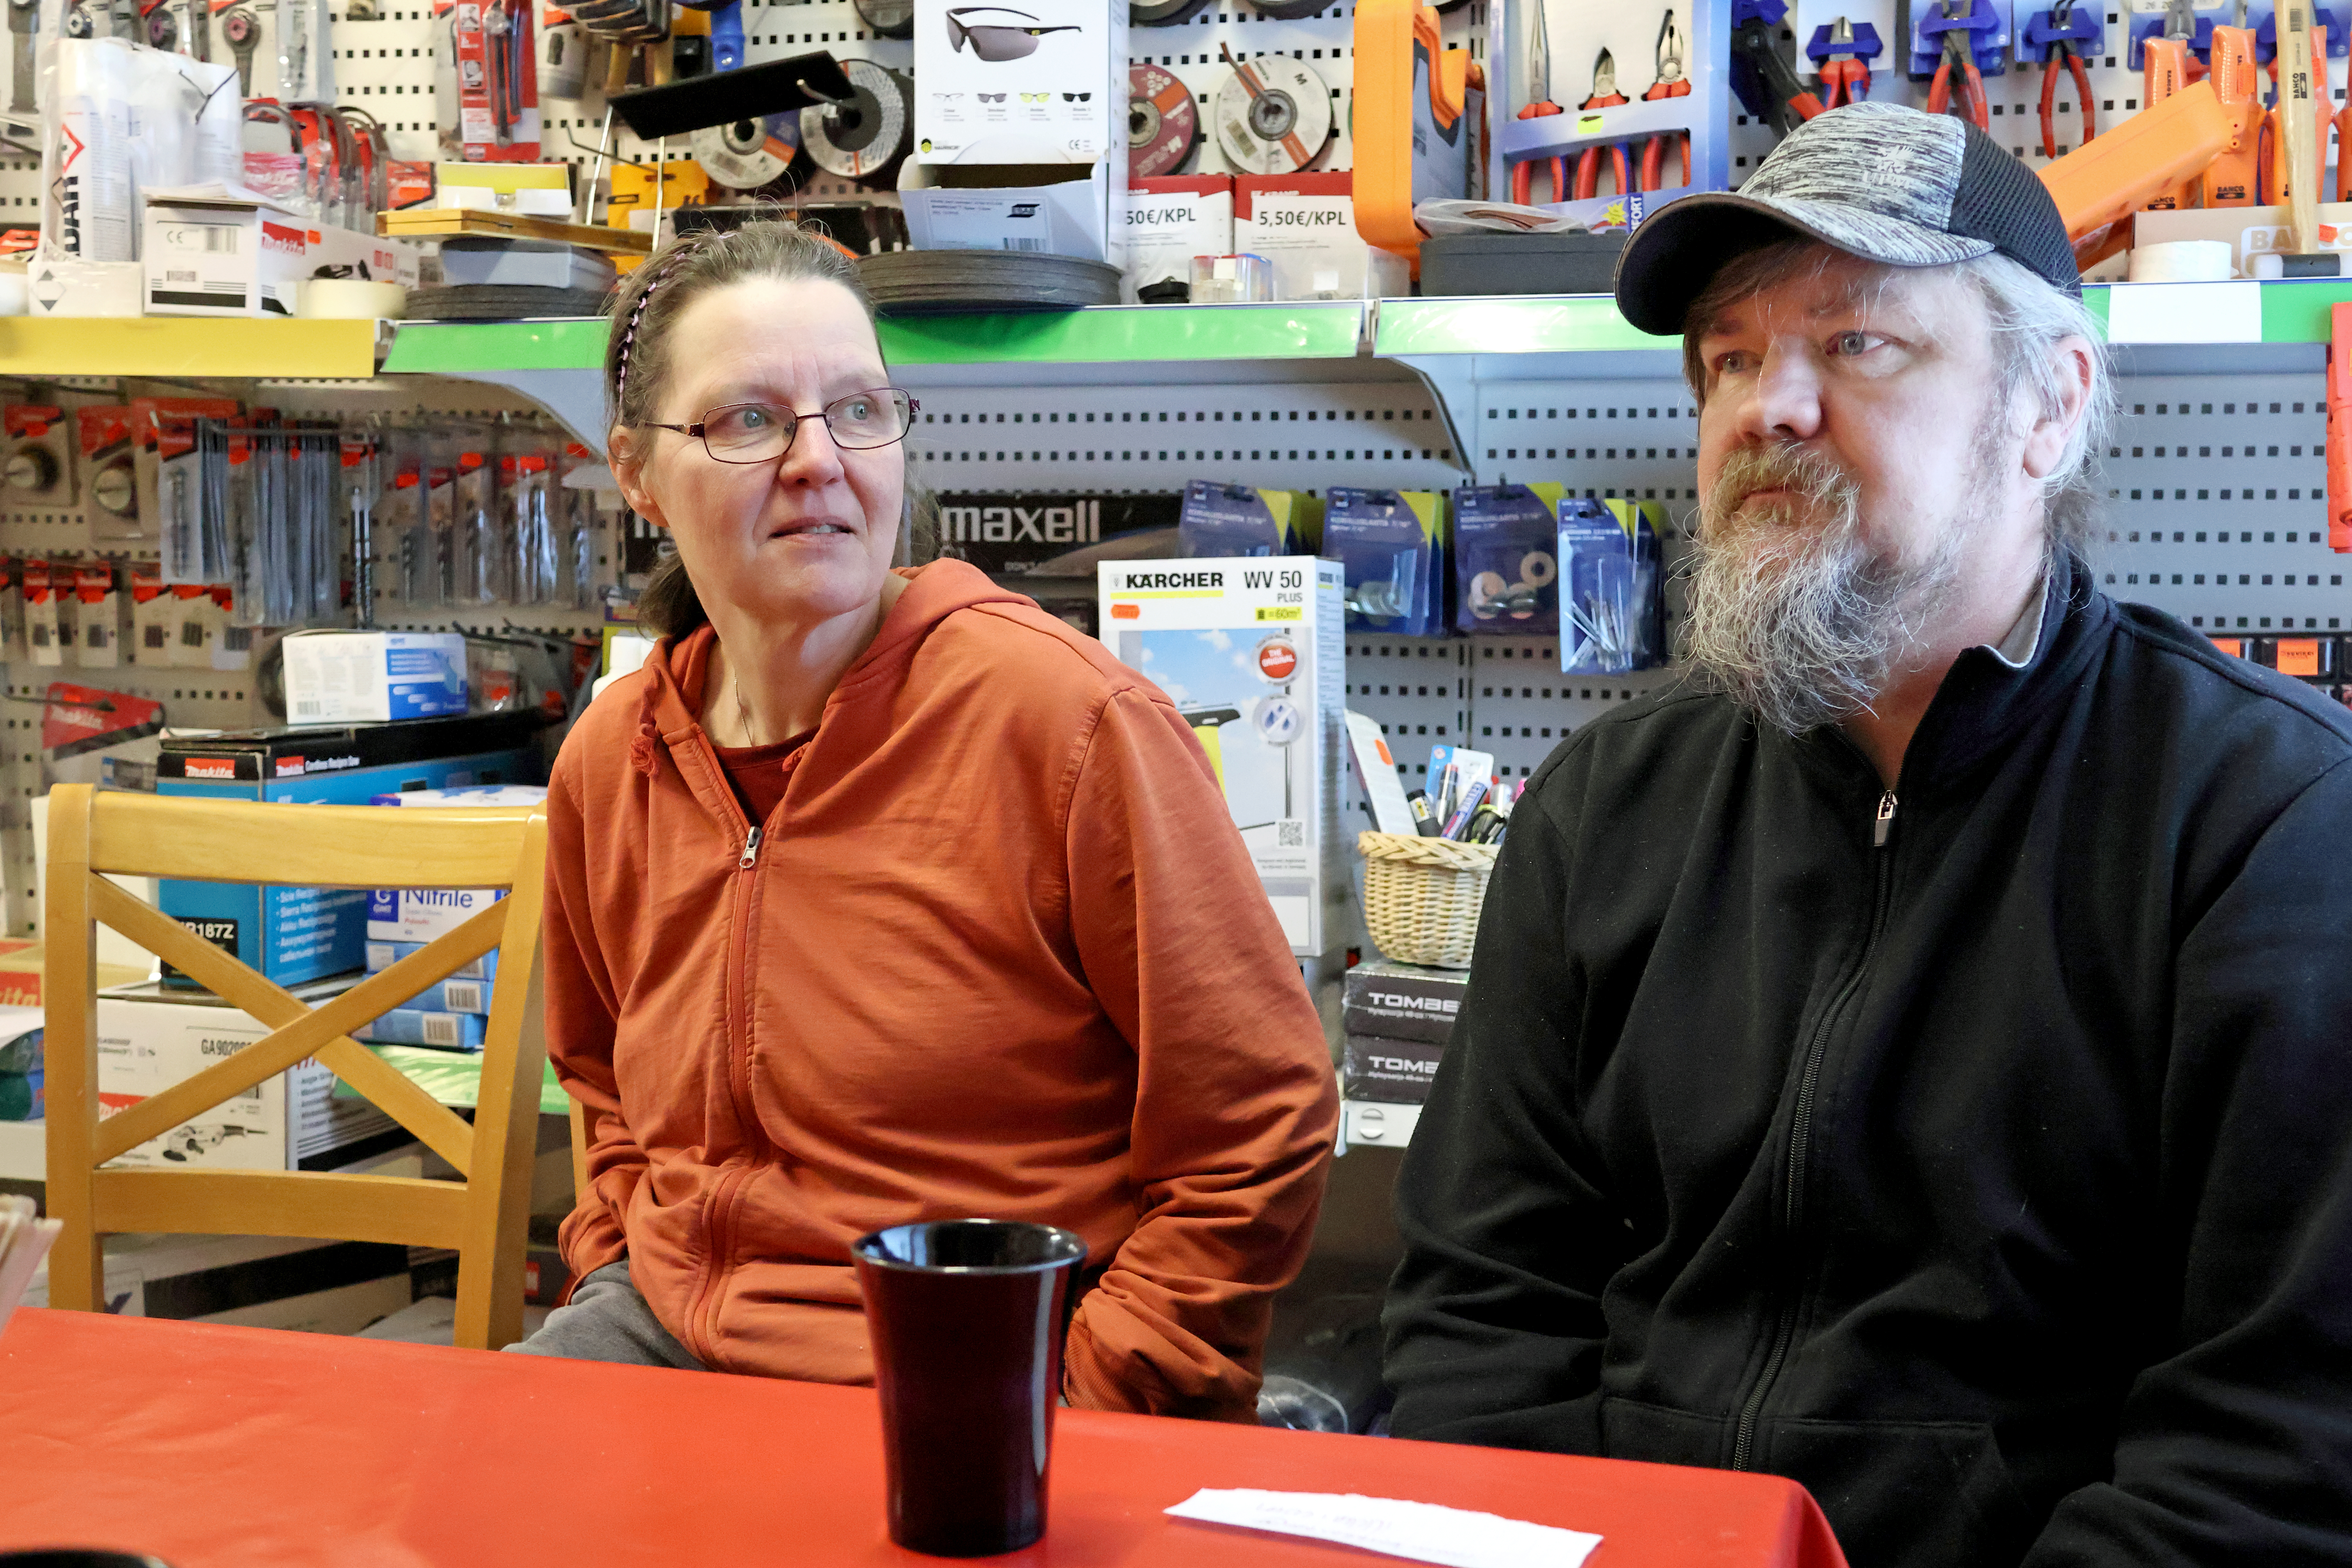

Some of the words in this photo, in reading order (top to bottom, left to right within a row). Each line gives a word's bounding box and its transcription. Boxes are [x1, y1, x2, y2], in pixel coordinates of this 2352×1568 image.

[1127, 208, 1196, 225] 50€/KPL
[1259, 211, 1346, 227] 5,50€/KPL
[1630, 196, 1642, 230] FORT
[941, 500, 1100, 543] maxell
[1127, 572, 1223, 588] KÄRCHER
[1244, 571, 1273, 589] WV
[1280, 571, 1302, 588] 50
[1277, 592, 1303, 603] PLUS
[405, 890, 473, 908] Nitrile
